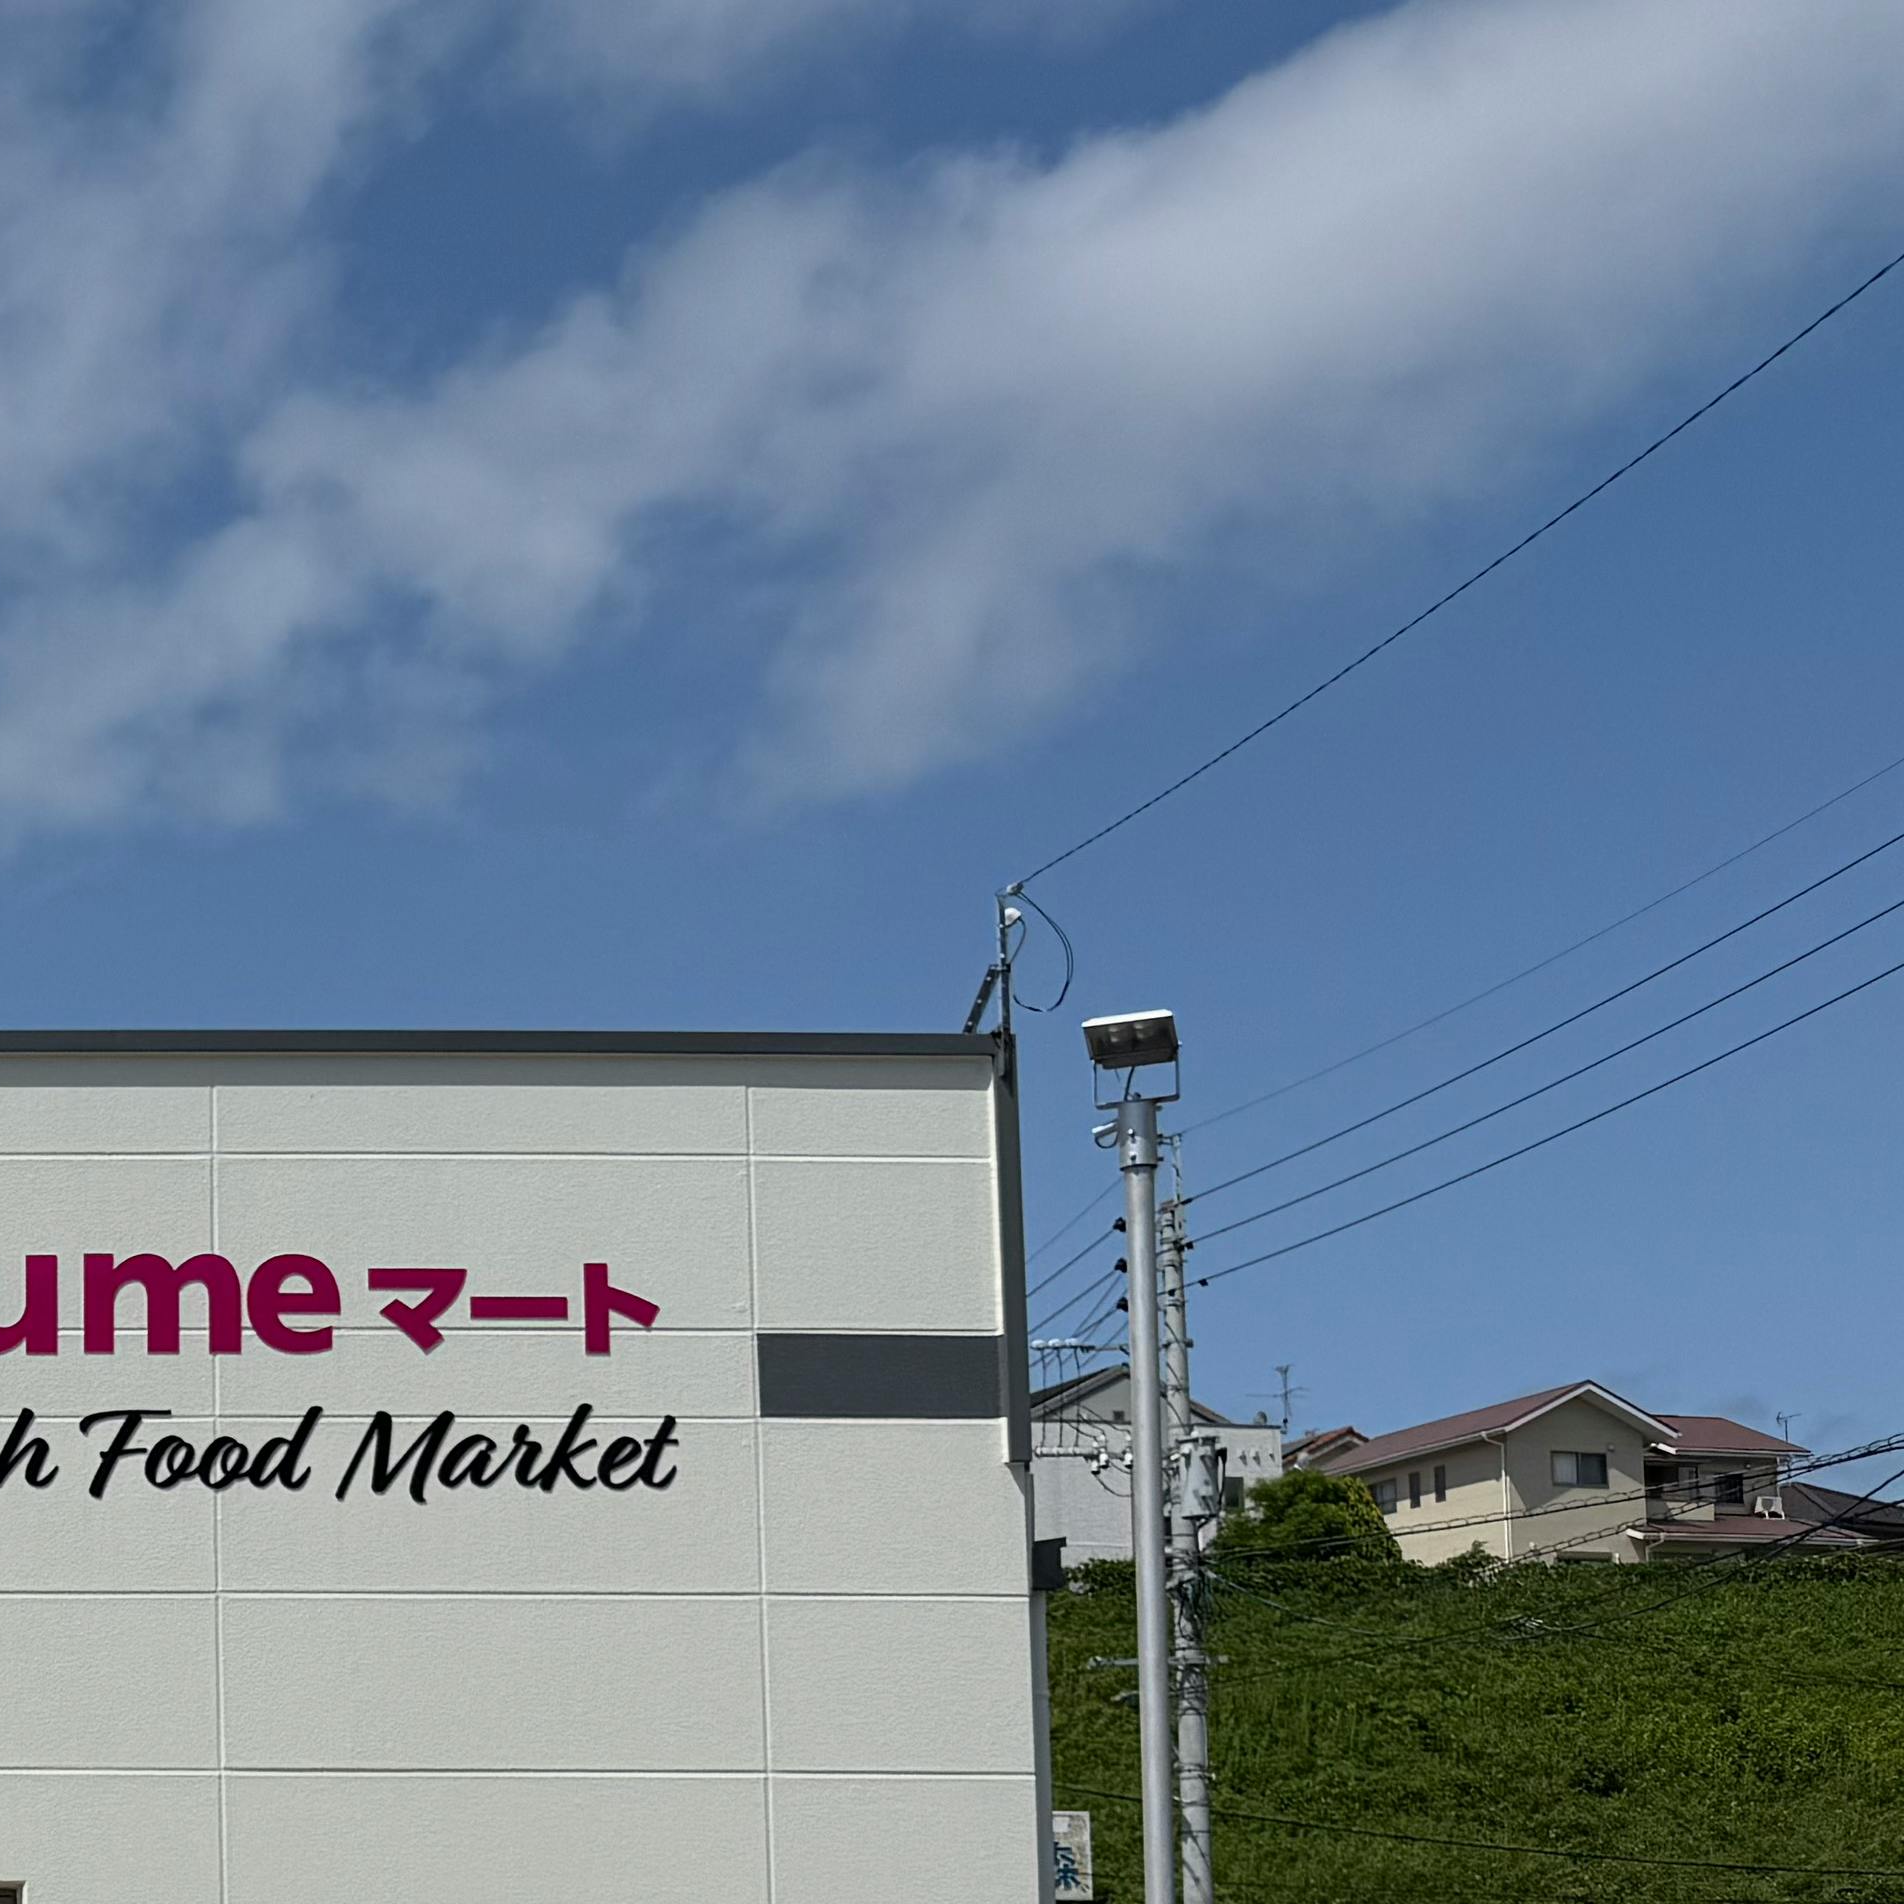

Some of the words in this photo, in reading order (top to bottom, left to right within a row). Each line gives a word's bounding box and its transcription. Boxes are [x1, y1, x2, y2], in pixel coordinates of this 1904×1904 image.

[366, 1261, 659, 1355] マート
[79, 1405, 312, 1499] Food
[336, 1403, 678, 1502] Market
